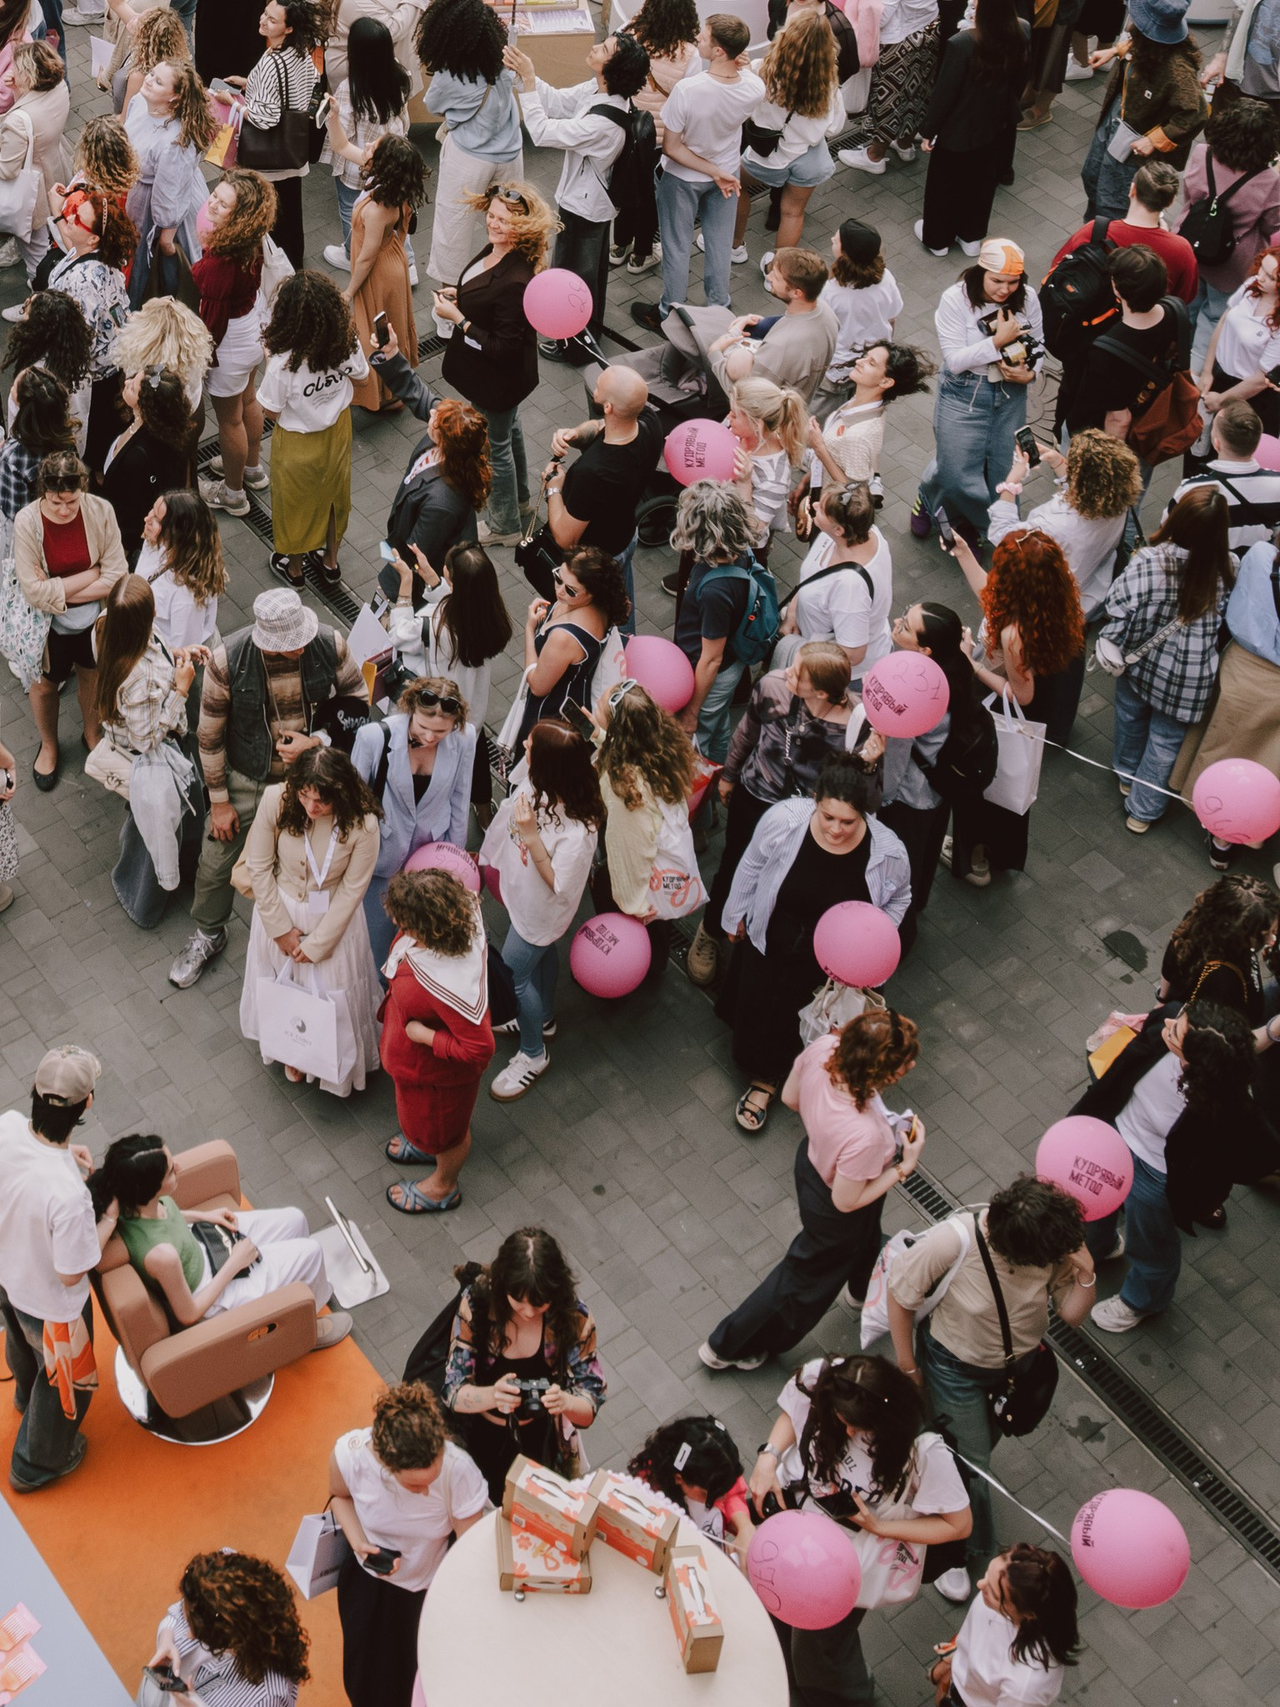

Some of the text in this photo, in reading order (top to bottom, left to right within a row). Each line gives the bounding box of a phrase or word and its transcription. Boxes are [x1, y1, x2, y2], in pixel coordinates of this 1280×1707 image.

[684, 427, 699, 468] КУДРЯВЫЙ
[695, 442, 707, 468] МЕТОД
[1068, 1169, 1103, 1196] МЕТОД
[1073, 1155, 1125, 1191] КУДРЯВЫЙ
